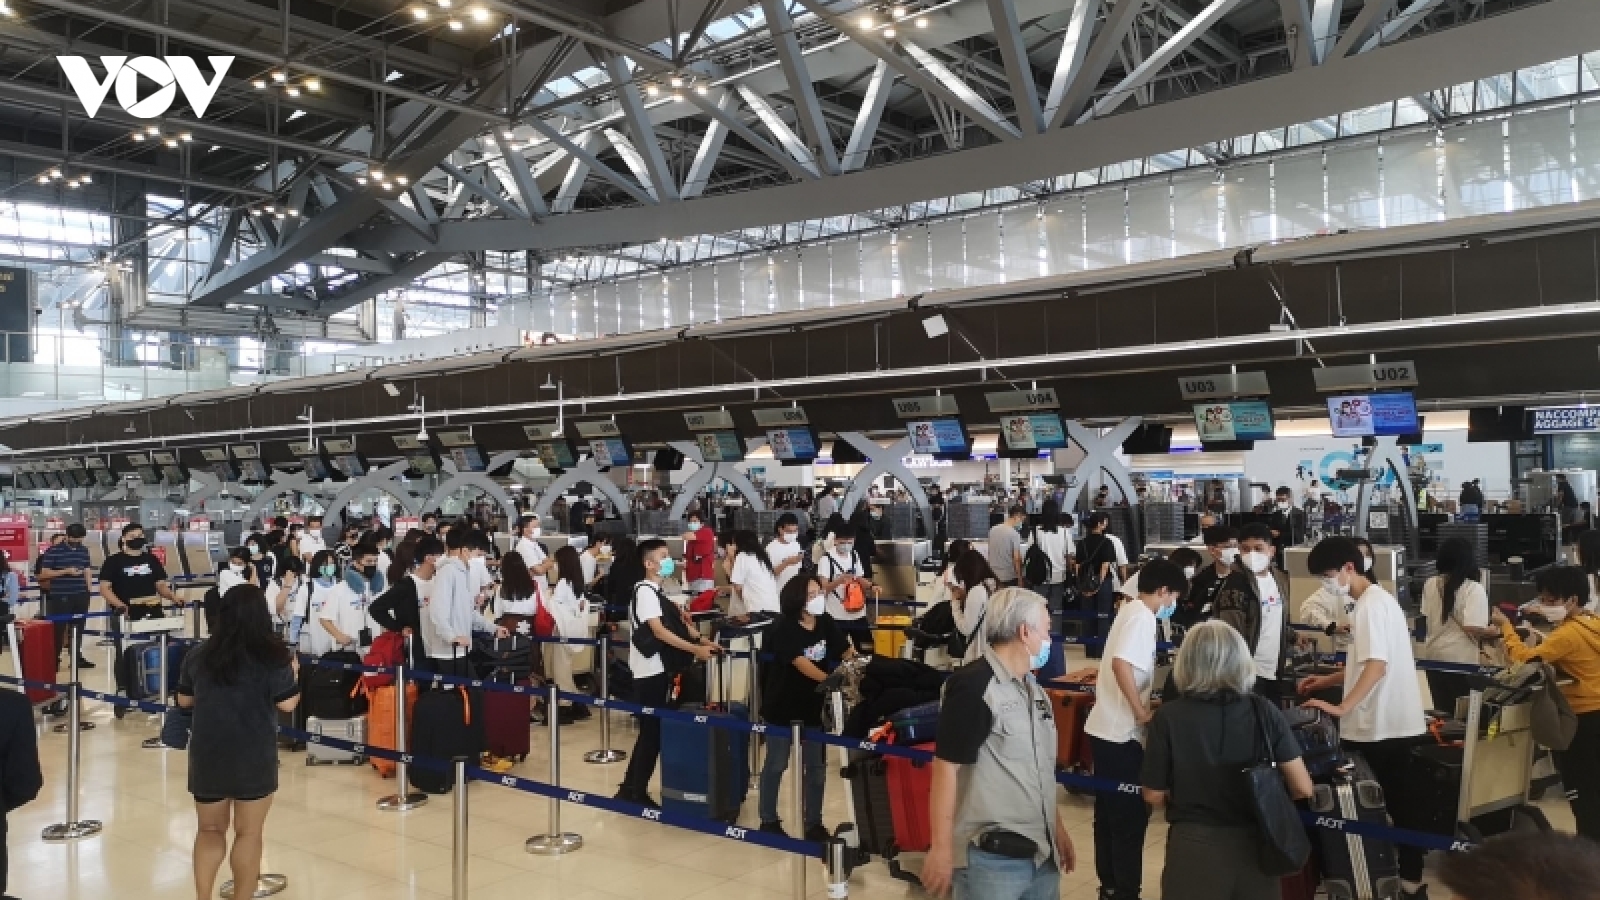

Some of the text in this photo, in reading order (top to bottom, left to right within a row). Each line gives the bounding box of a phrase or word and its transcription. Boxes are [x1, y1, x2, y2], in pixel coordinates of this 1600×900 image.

[1373, 368, 1409, 381] U02
[1185, 380, 1216, 393] U03
[1026, 393, 1053, 405] U04
[897, 401, 921, 413] U05
[1536, 409, 1600, 419] NACCOMP
[1118, 782, 1142, 794] AOT
[642, 808, 662, 820] AOT
[1316, 816, 1345, 830] AOT
[725, 826, 747, 839] AOT
